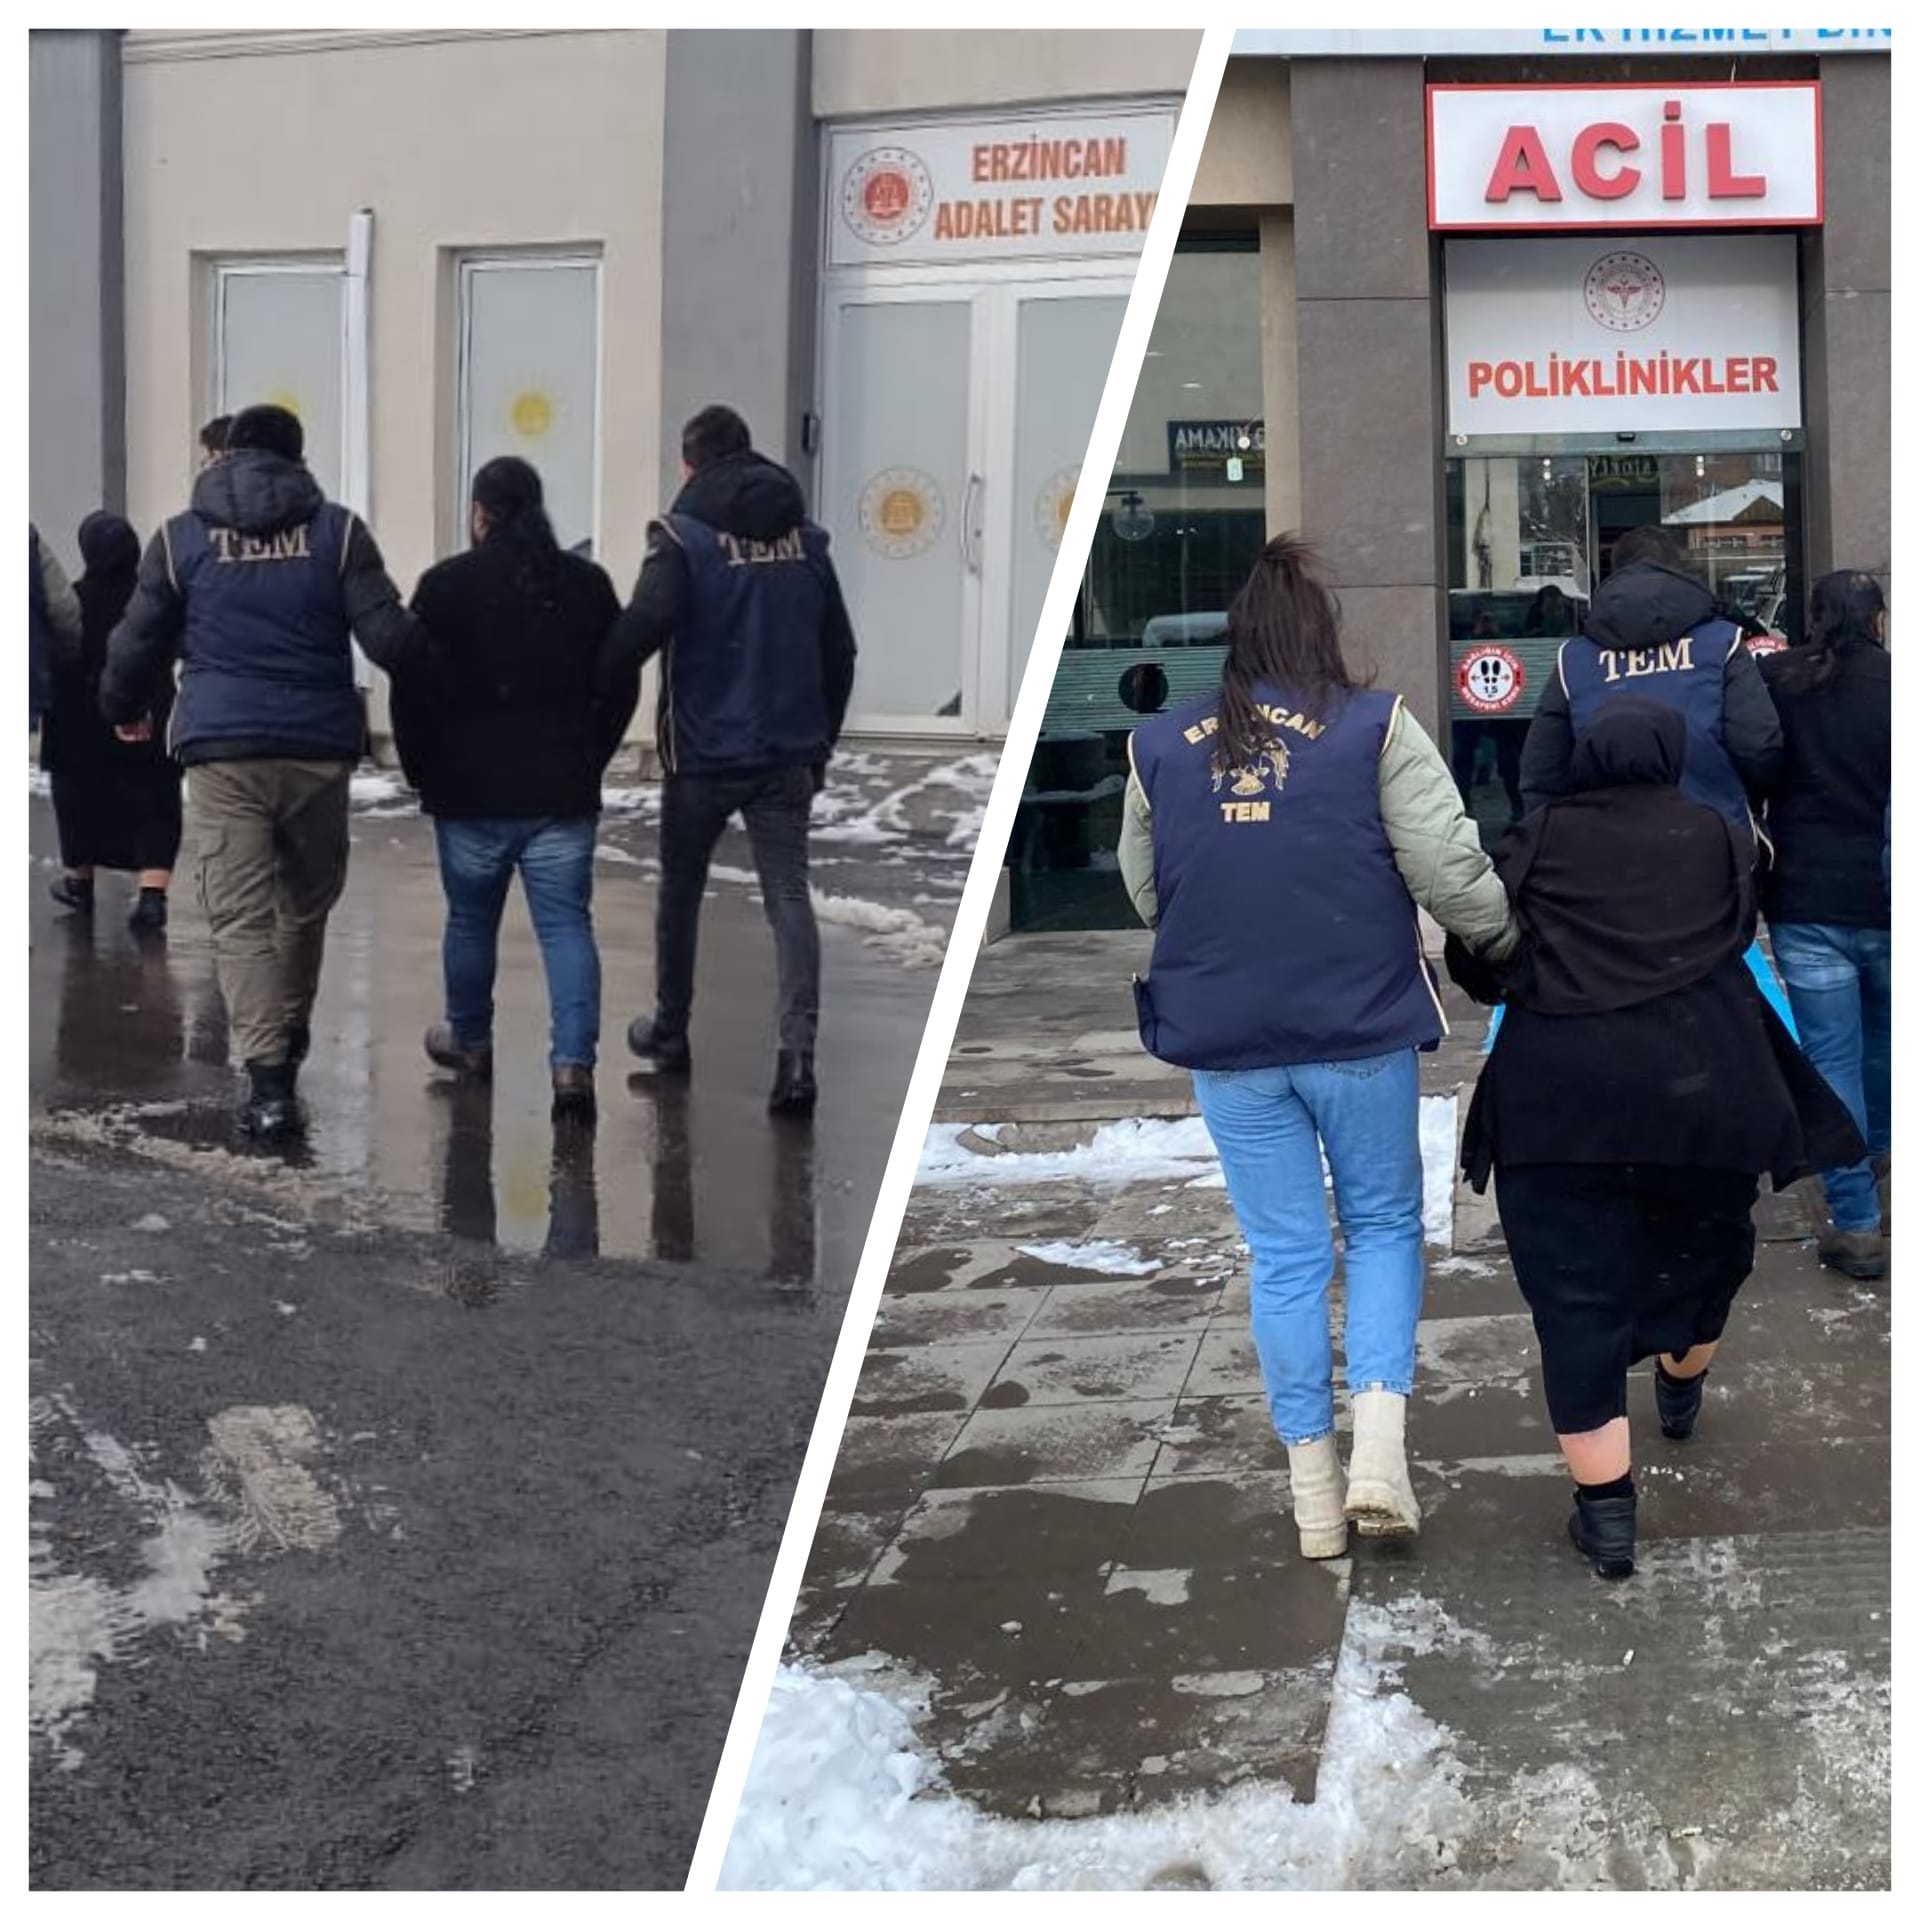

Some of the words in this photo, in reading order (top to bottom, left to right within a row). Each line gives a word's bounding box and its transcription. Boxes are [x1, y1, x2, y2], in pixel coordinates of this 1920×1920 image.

[972, 132, 1127, 182] ERZİNCAN
[1485, 101, 1766, 202] ACİL
[935, 198, 1044, 239] ADALET
[1469, 350, 1779, 397] POLİKLİNİKLER
[209, 523, 311, 563] TEM
[1599, 637, 1695, 682] TEM
[1183, 704, 1327, 745] ERNCAN
[1221, 801, 1271, 823] TEM
